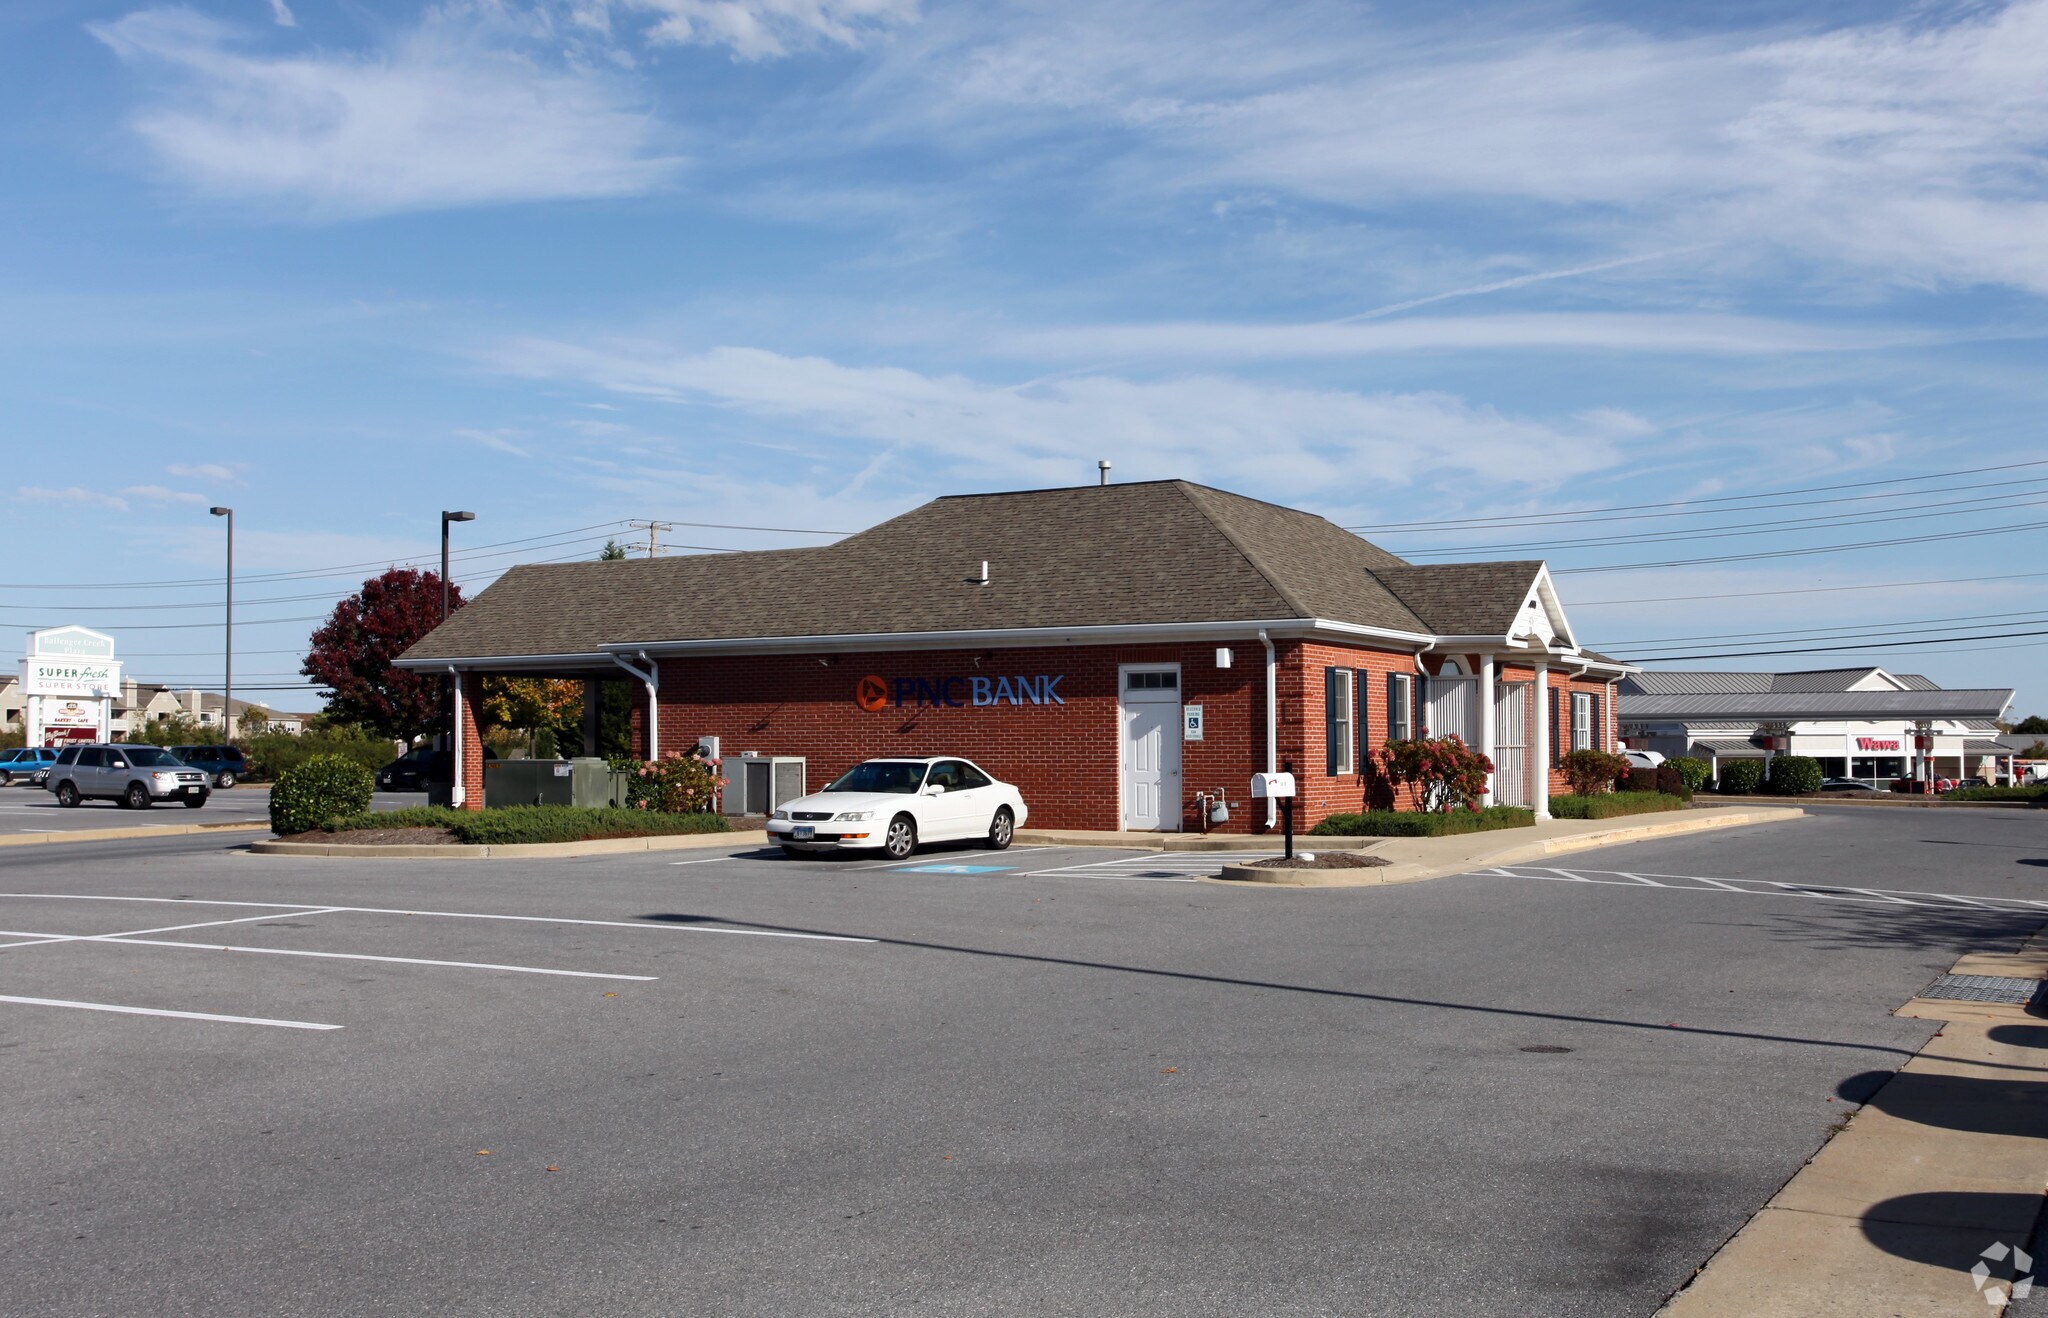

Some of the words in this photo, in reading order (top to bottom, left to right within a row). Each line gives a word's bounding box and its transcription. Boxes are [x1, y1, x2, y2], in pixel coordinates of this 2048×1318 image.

[84, 639, 106, 647] Creek
[39, 667, 78, 678] SUPER
[77, 667, 109, 682] fresh
[38, 681, 73, 689] SUPER
[76, 682, 109, 691] STORE
[895, 676, 965, 707] PNC
[968, 675, 1066, 706] BANK
[1856, 737, 1900, 751] Wawa
